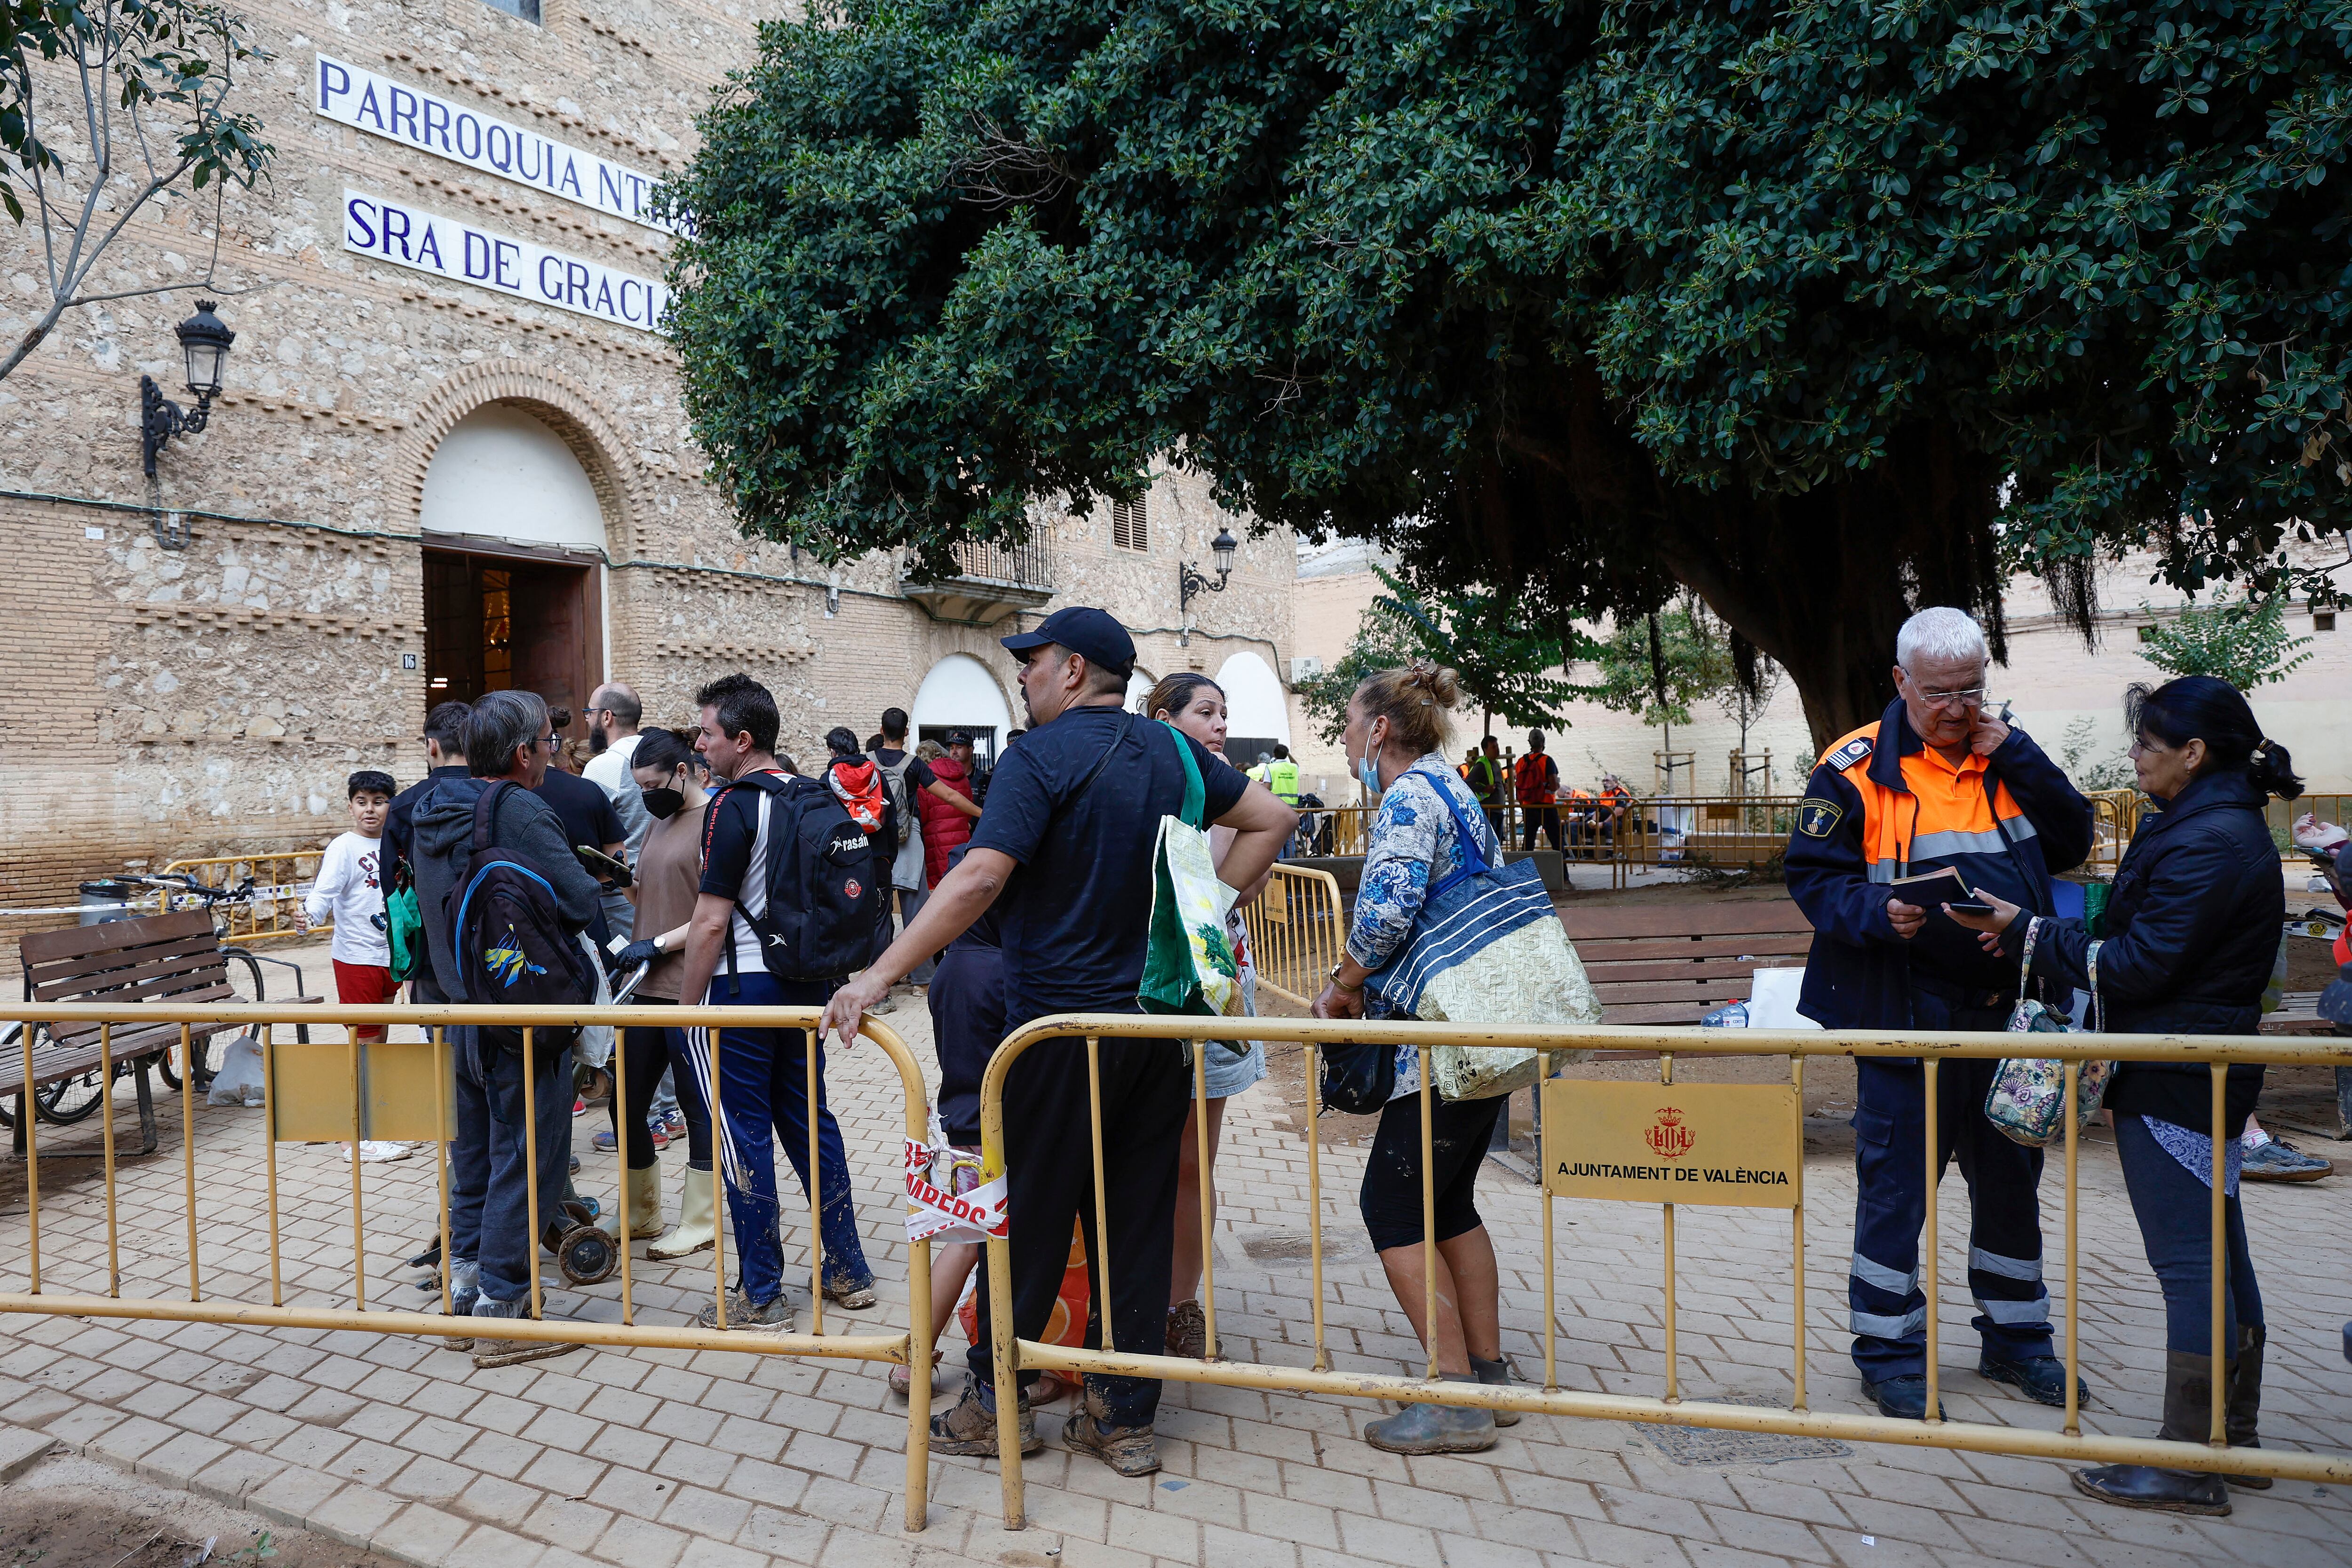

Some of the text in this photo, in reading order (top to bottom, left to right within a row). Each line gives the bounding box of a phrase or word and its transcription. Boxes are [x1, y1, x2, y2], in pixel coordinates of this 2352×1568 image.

[319, 59, 583, 199] PARROQUIA
[348, 199, 444, 269] SRA
[462, 230, 520, 290] DE
[405, 655, 415, 669] 16
[715, 794, 726, 806] FIFA
[1829, 805, 1839, 814] CIVIL
[1557, 1162, 1788, 1185] AJUNTAMENT DE VALÈNCIA
